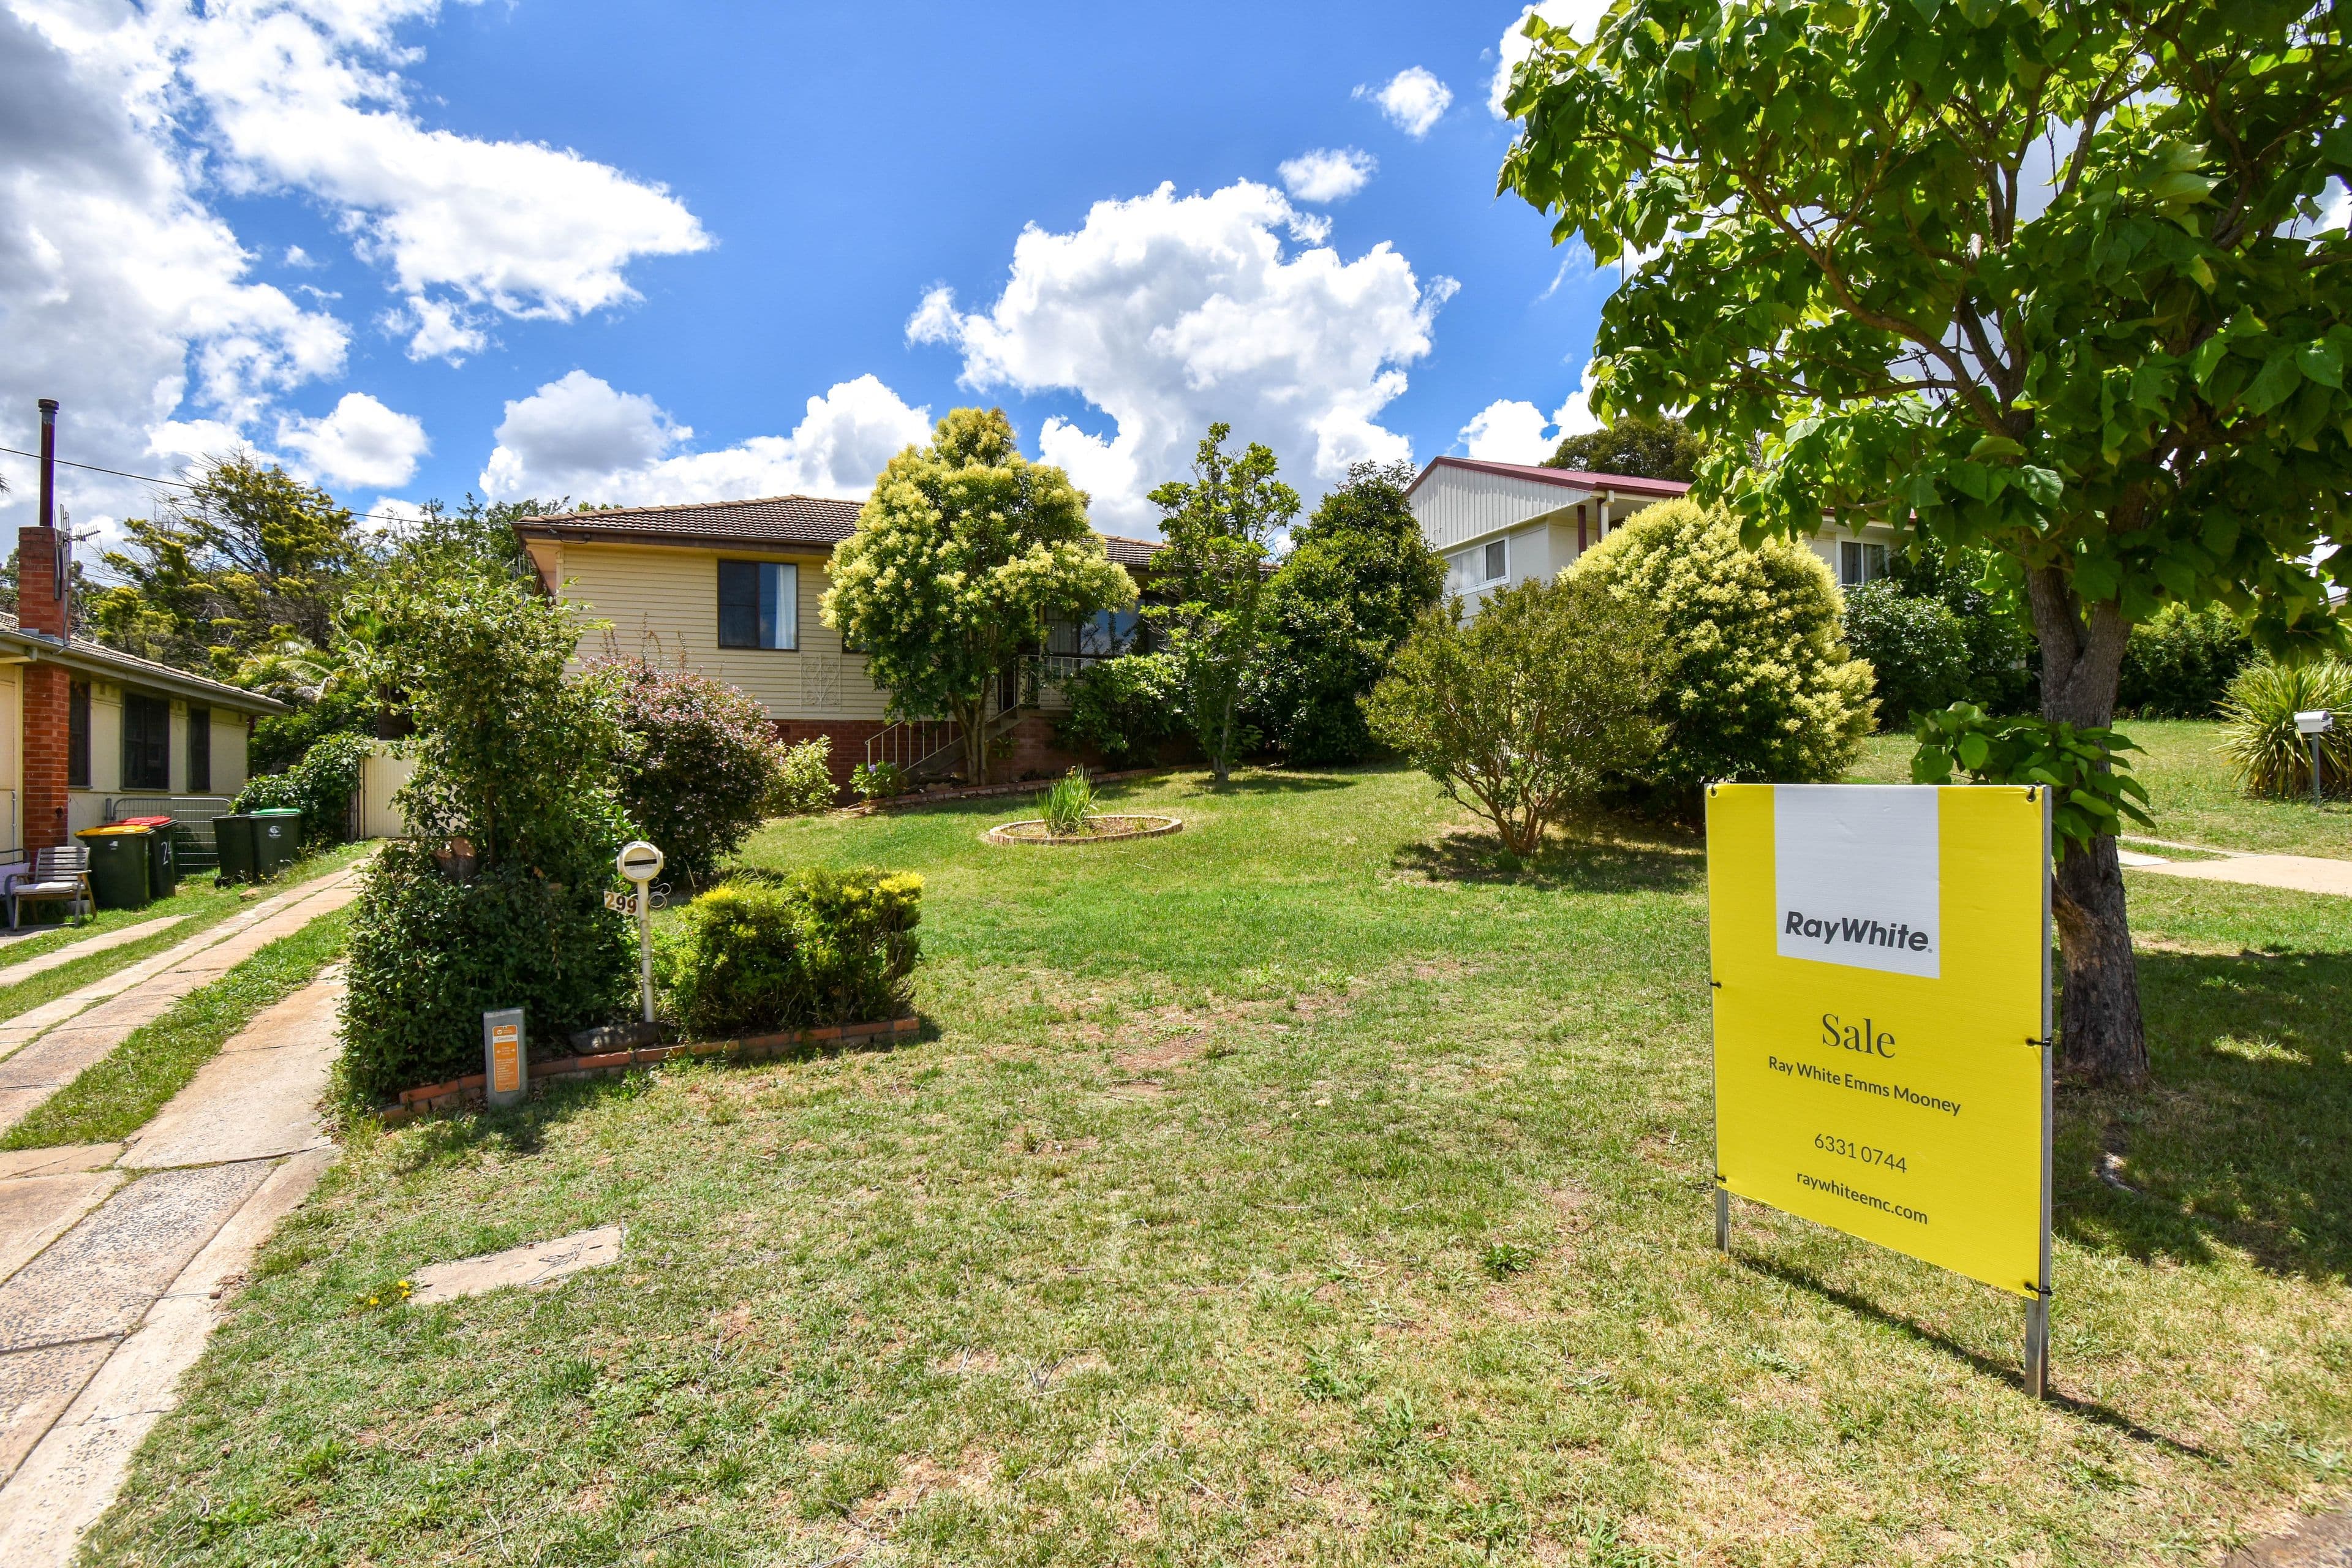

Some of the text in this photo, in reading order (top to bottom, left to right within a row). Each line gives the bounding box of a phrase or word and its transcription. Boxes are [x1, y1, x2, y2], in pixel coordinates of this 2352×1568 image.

[605, 892, 637, 914] 299
[1822, 1013, 1896, 1058] Sale
[1769, 1055, 1961, 1117] Ray White Emms Mooney
[1814, 1133, 1907, 1174] 6331 0744
[1797, 1172, 1928, 1225] raywhiteemc.com
